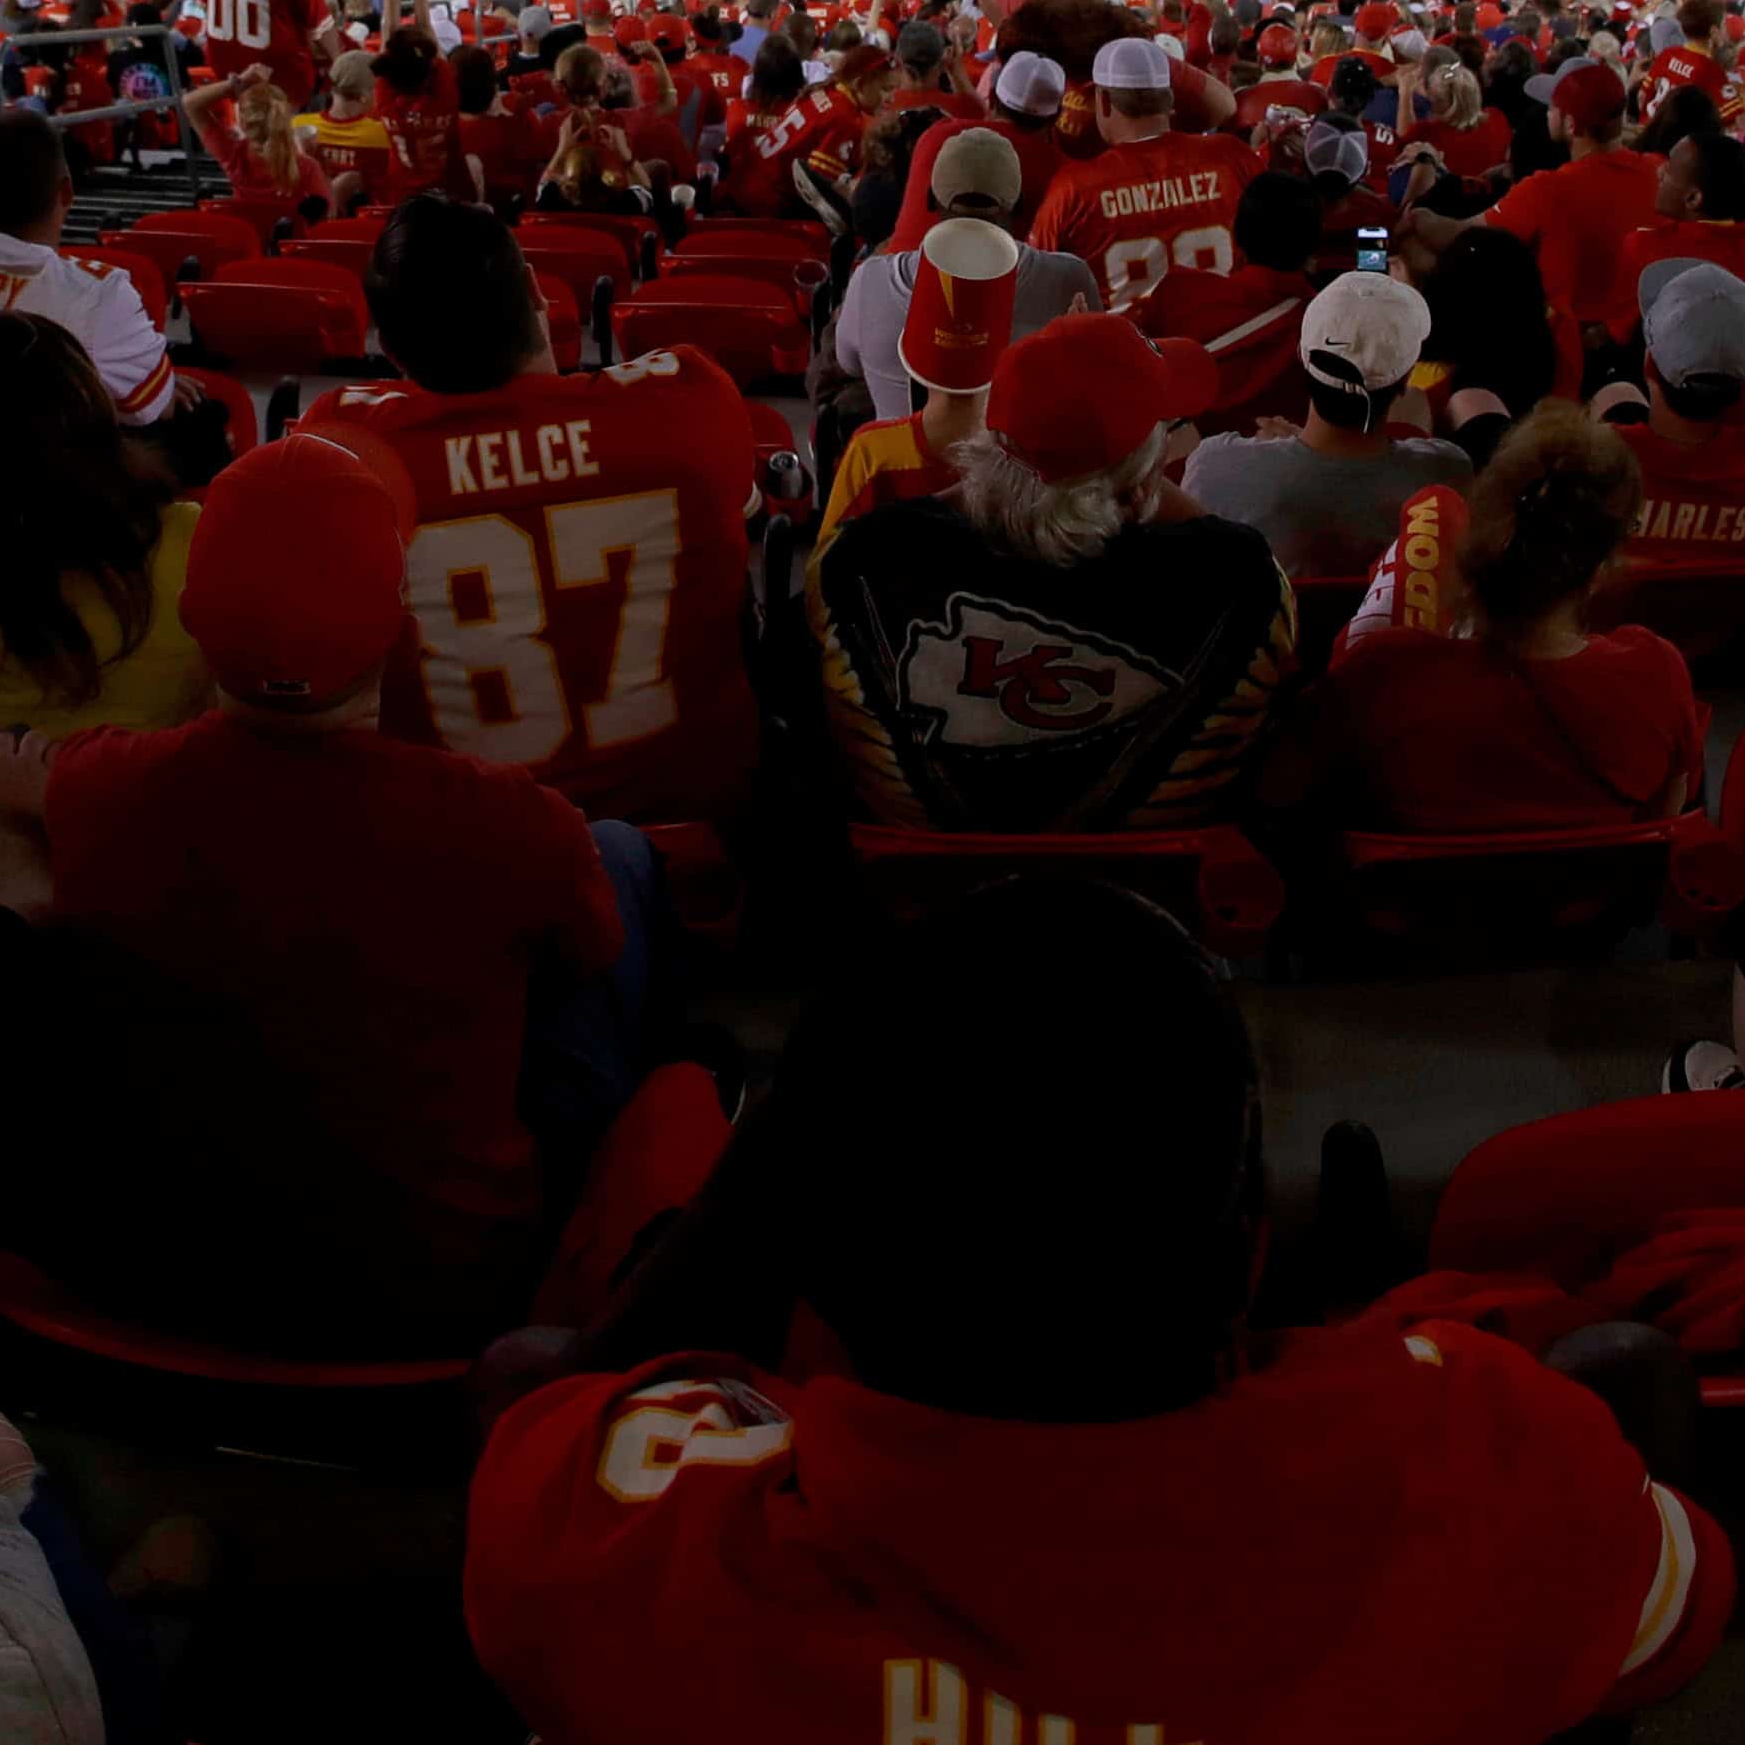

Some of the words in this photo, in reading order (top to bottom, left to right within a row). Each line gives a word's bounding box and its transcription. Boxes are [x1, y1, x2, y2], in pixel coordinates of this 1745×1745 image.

[1099, 172, 1223, 218] GONZALEZ
[444, 419, 600, 496] KELCE
[403, 486, 681, 769] 87
